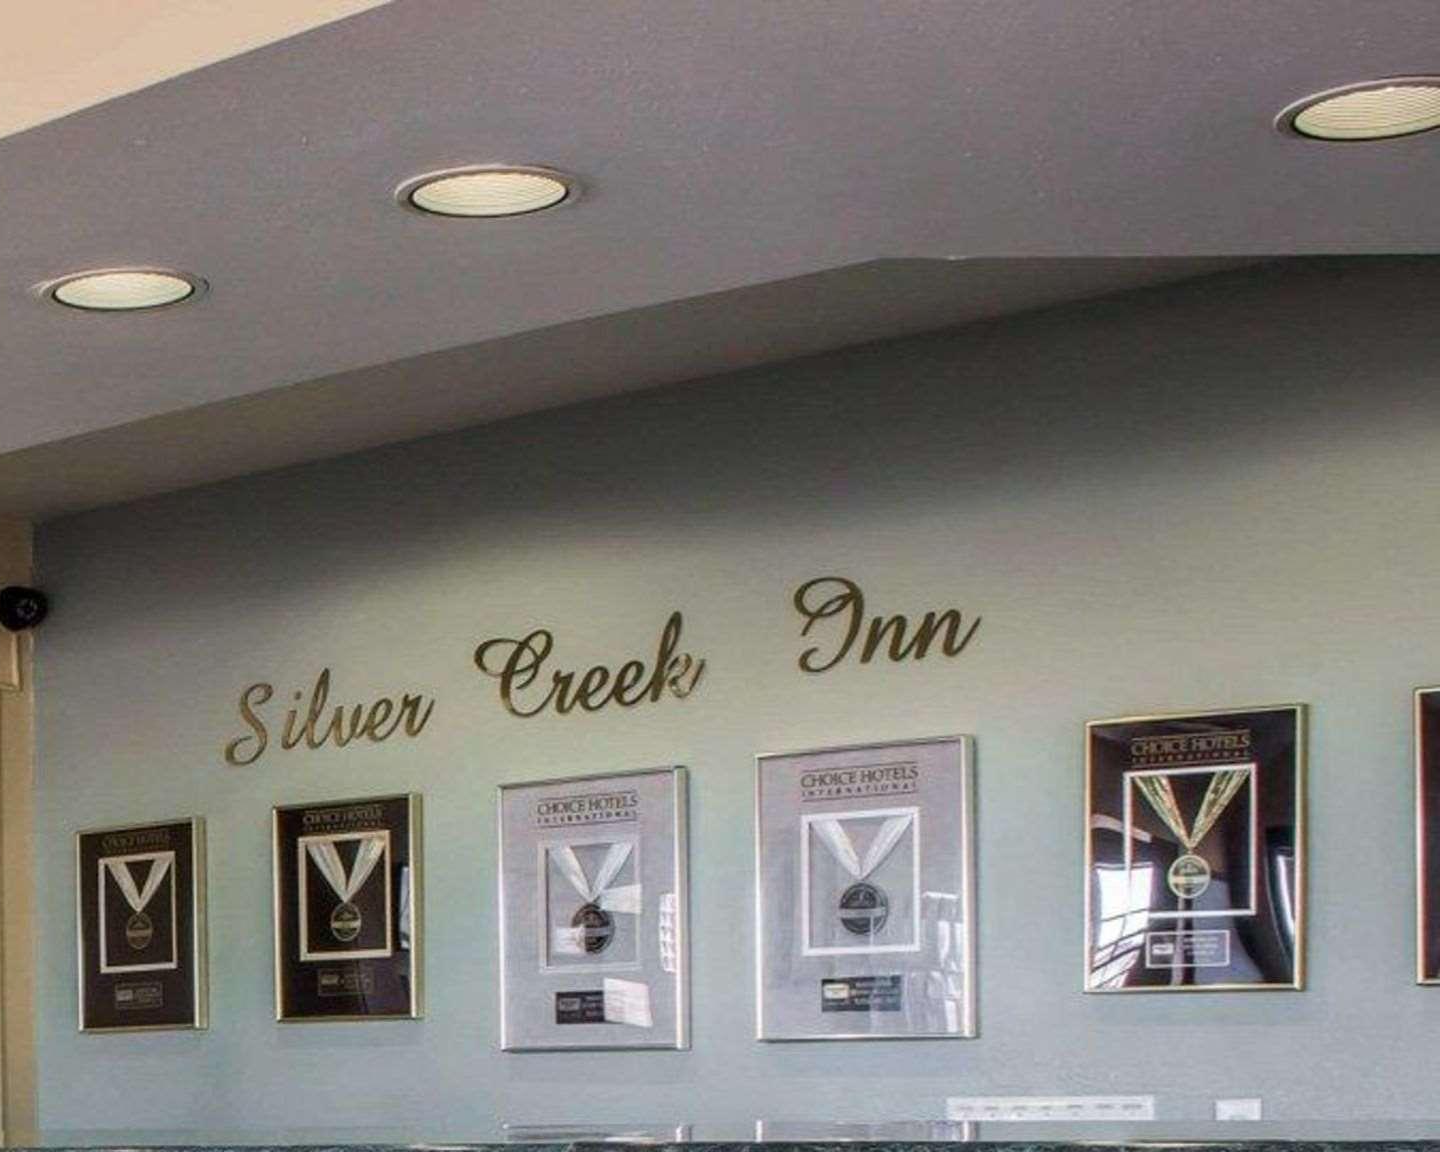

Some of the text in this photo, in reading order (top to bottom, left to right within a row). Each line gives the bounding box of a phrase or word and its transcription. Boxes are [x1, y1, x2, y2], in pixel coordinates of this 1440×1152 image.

[224, 576, 981, 766] Silver Creek Inn
[1131, 734, 1251, 757] CHOICE HOTELS
[800, 765, 920, 789] CHOICE HOTELS
[801, 782, 917, 798] INTERNATIONAL
[537, 793, 639, 816] CHOICE HOTELS
